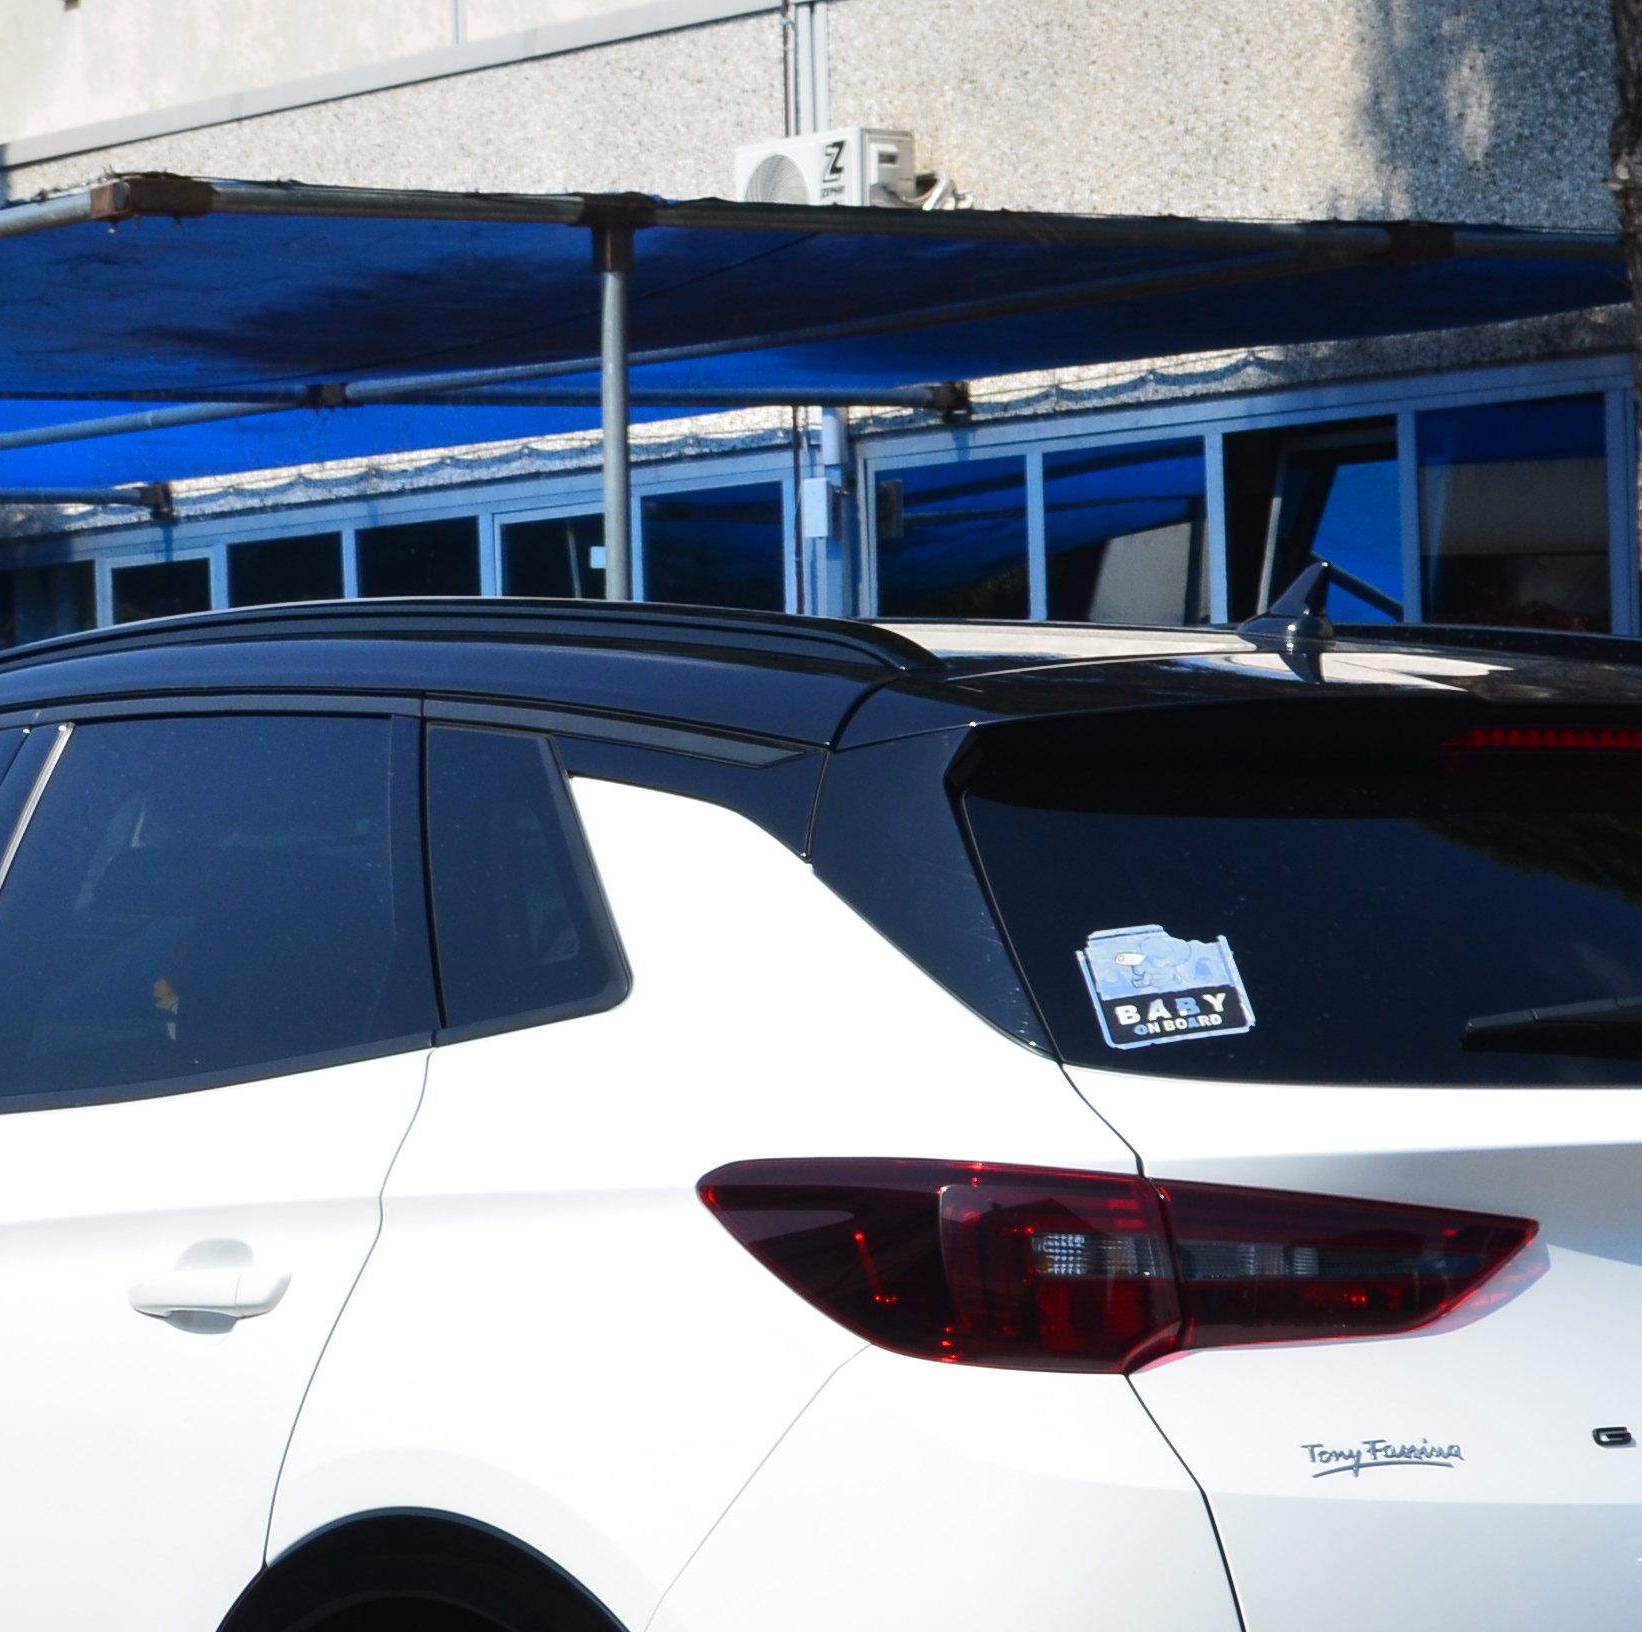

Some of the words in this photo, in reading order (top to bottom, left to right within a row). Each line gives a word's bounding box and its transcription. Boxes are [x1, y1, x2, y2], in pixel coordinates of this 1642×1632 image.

[1113, 992, 1227, 1026] BABY
[1133, 1021, 1161, 1036] ON
[1163, 1013, 1223, 1032] BOARD
[1300, 1443, 1362, 1478] Tony
